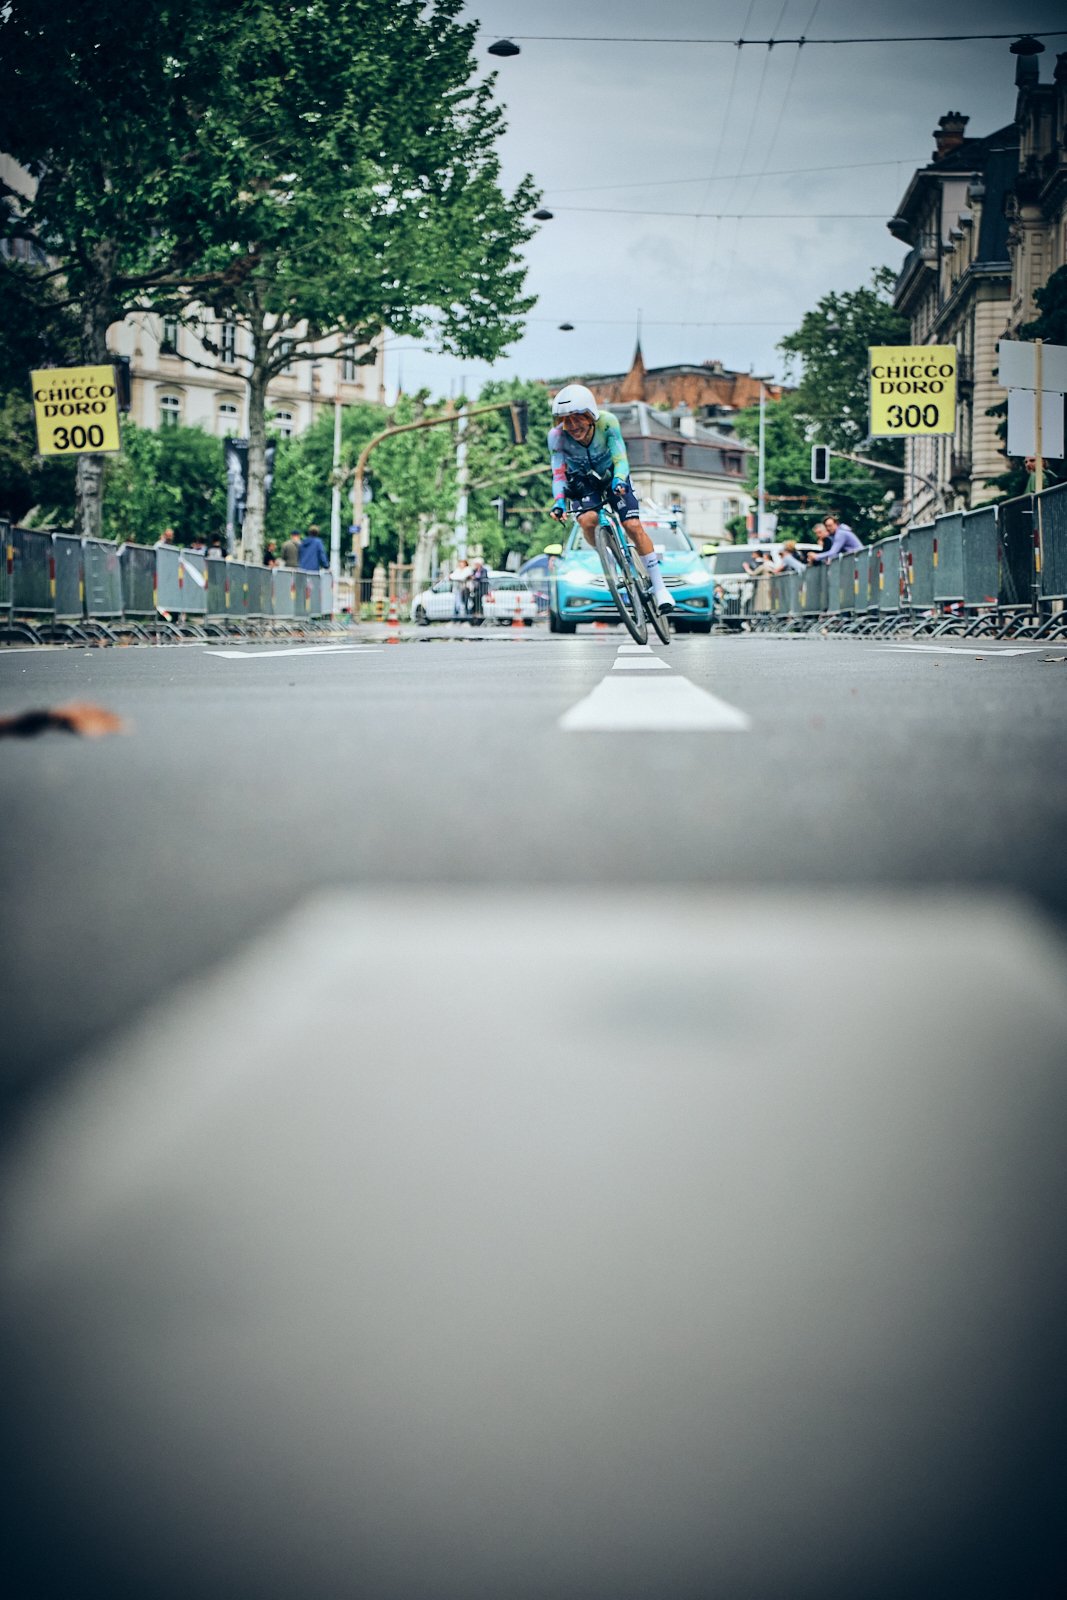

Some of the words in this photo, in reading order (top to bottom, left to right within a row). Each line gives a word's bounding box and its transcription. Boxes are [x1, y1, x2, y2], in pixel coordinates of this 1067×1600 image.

[872, 364, 953, 378] CHICCO
[35, 385, 114, 402] CHICCO
[880, 380, 944, 394] D'ORO
[44, 402, 106, 417] D'ORO
[887, 404, 939, 428] 300
[54, 425, 103, 449] 300
